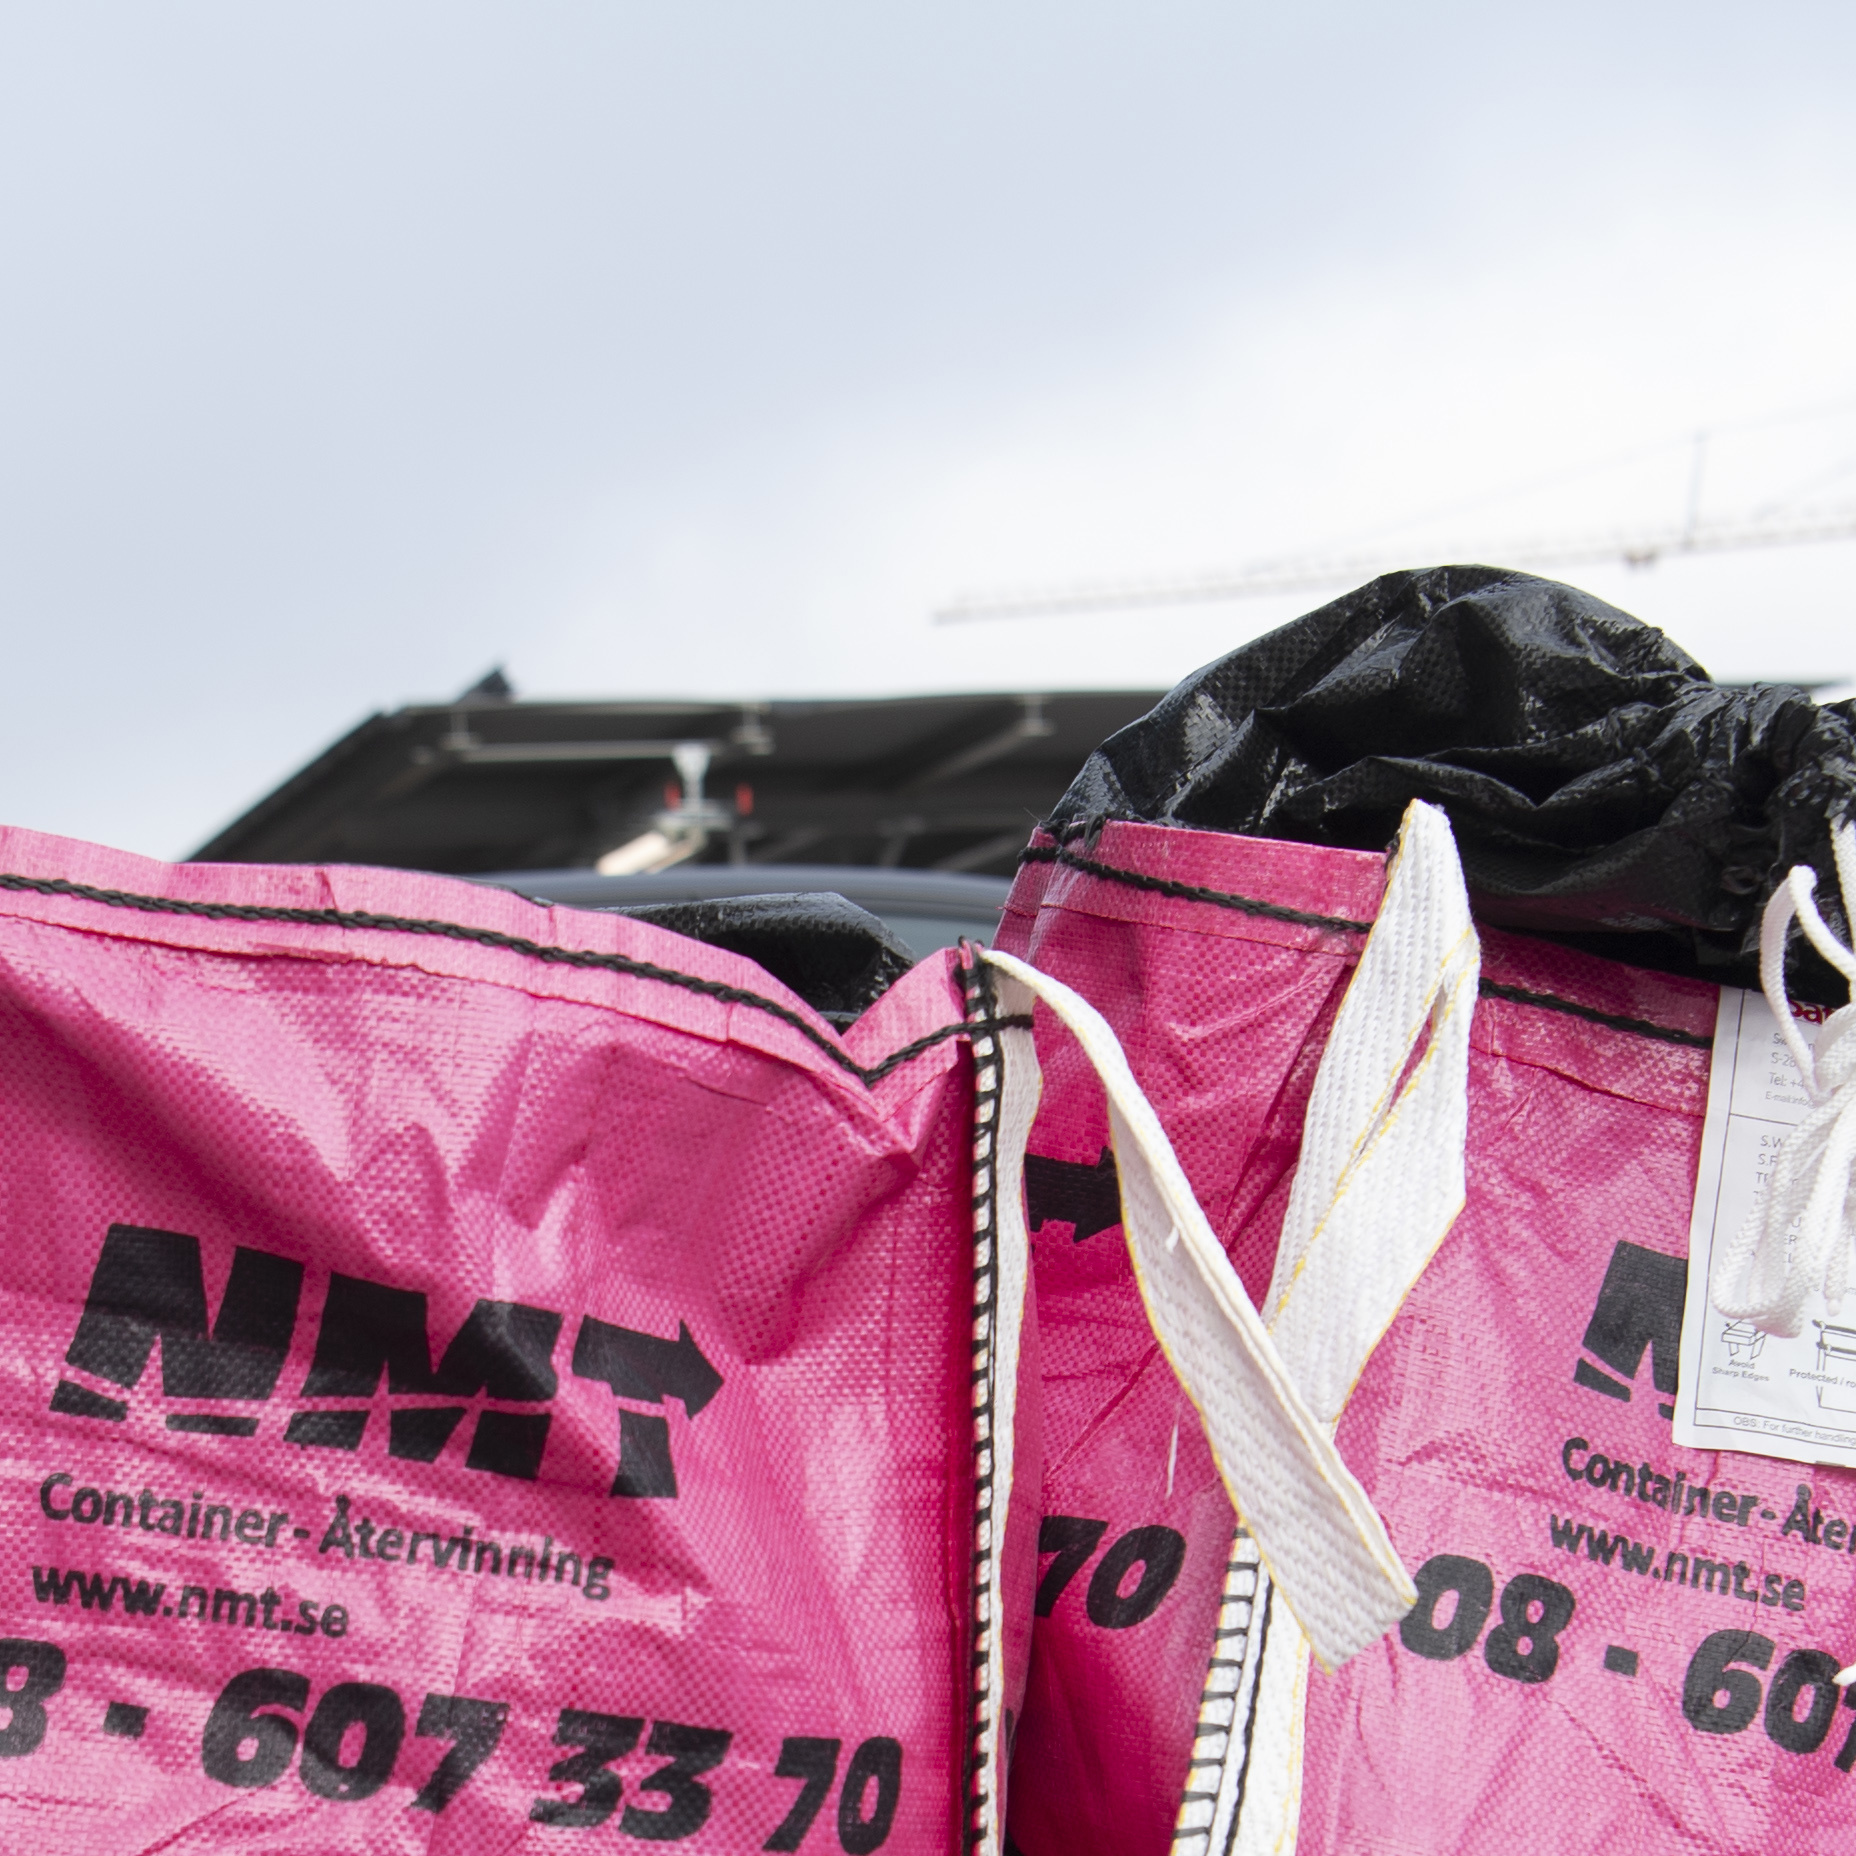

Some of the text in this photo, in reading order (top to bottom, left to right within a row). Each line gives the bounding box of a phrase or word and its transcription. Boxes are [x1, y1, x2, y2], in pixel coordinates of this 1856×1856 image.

[49, 1223, 724, 1499] NMT
[1711, 1365, 1771, 1383] Sharp Edges
[1788, 1367, 1838, 1386] Protected
[1732, 1415, 1760, 1430] OBS:
[1763, 1419, 1781, 1431] For
[1782, 1422, 1813, 1438] further
[1813, 1429, 1856, 1448] handling
[31, 1561, 351, 1640] www.nmt.se
[1550, 1513, 1807, 1612] www.nmt.se
[1397, 1553, 1577, 1684] 08
[199, 1666, 512, 1815] 607
[528, 1707, 735, 1844] 33
